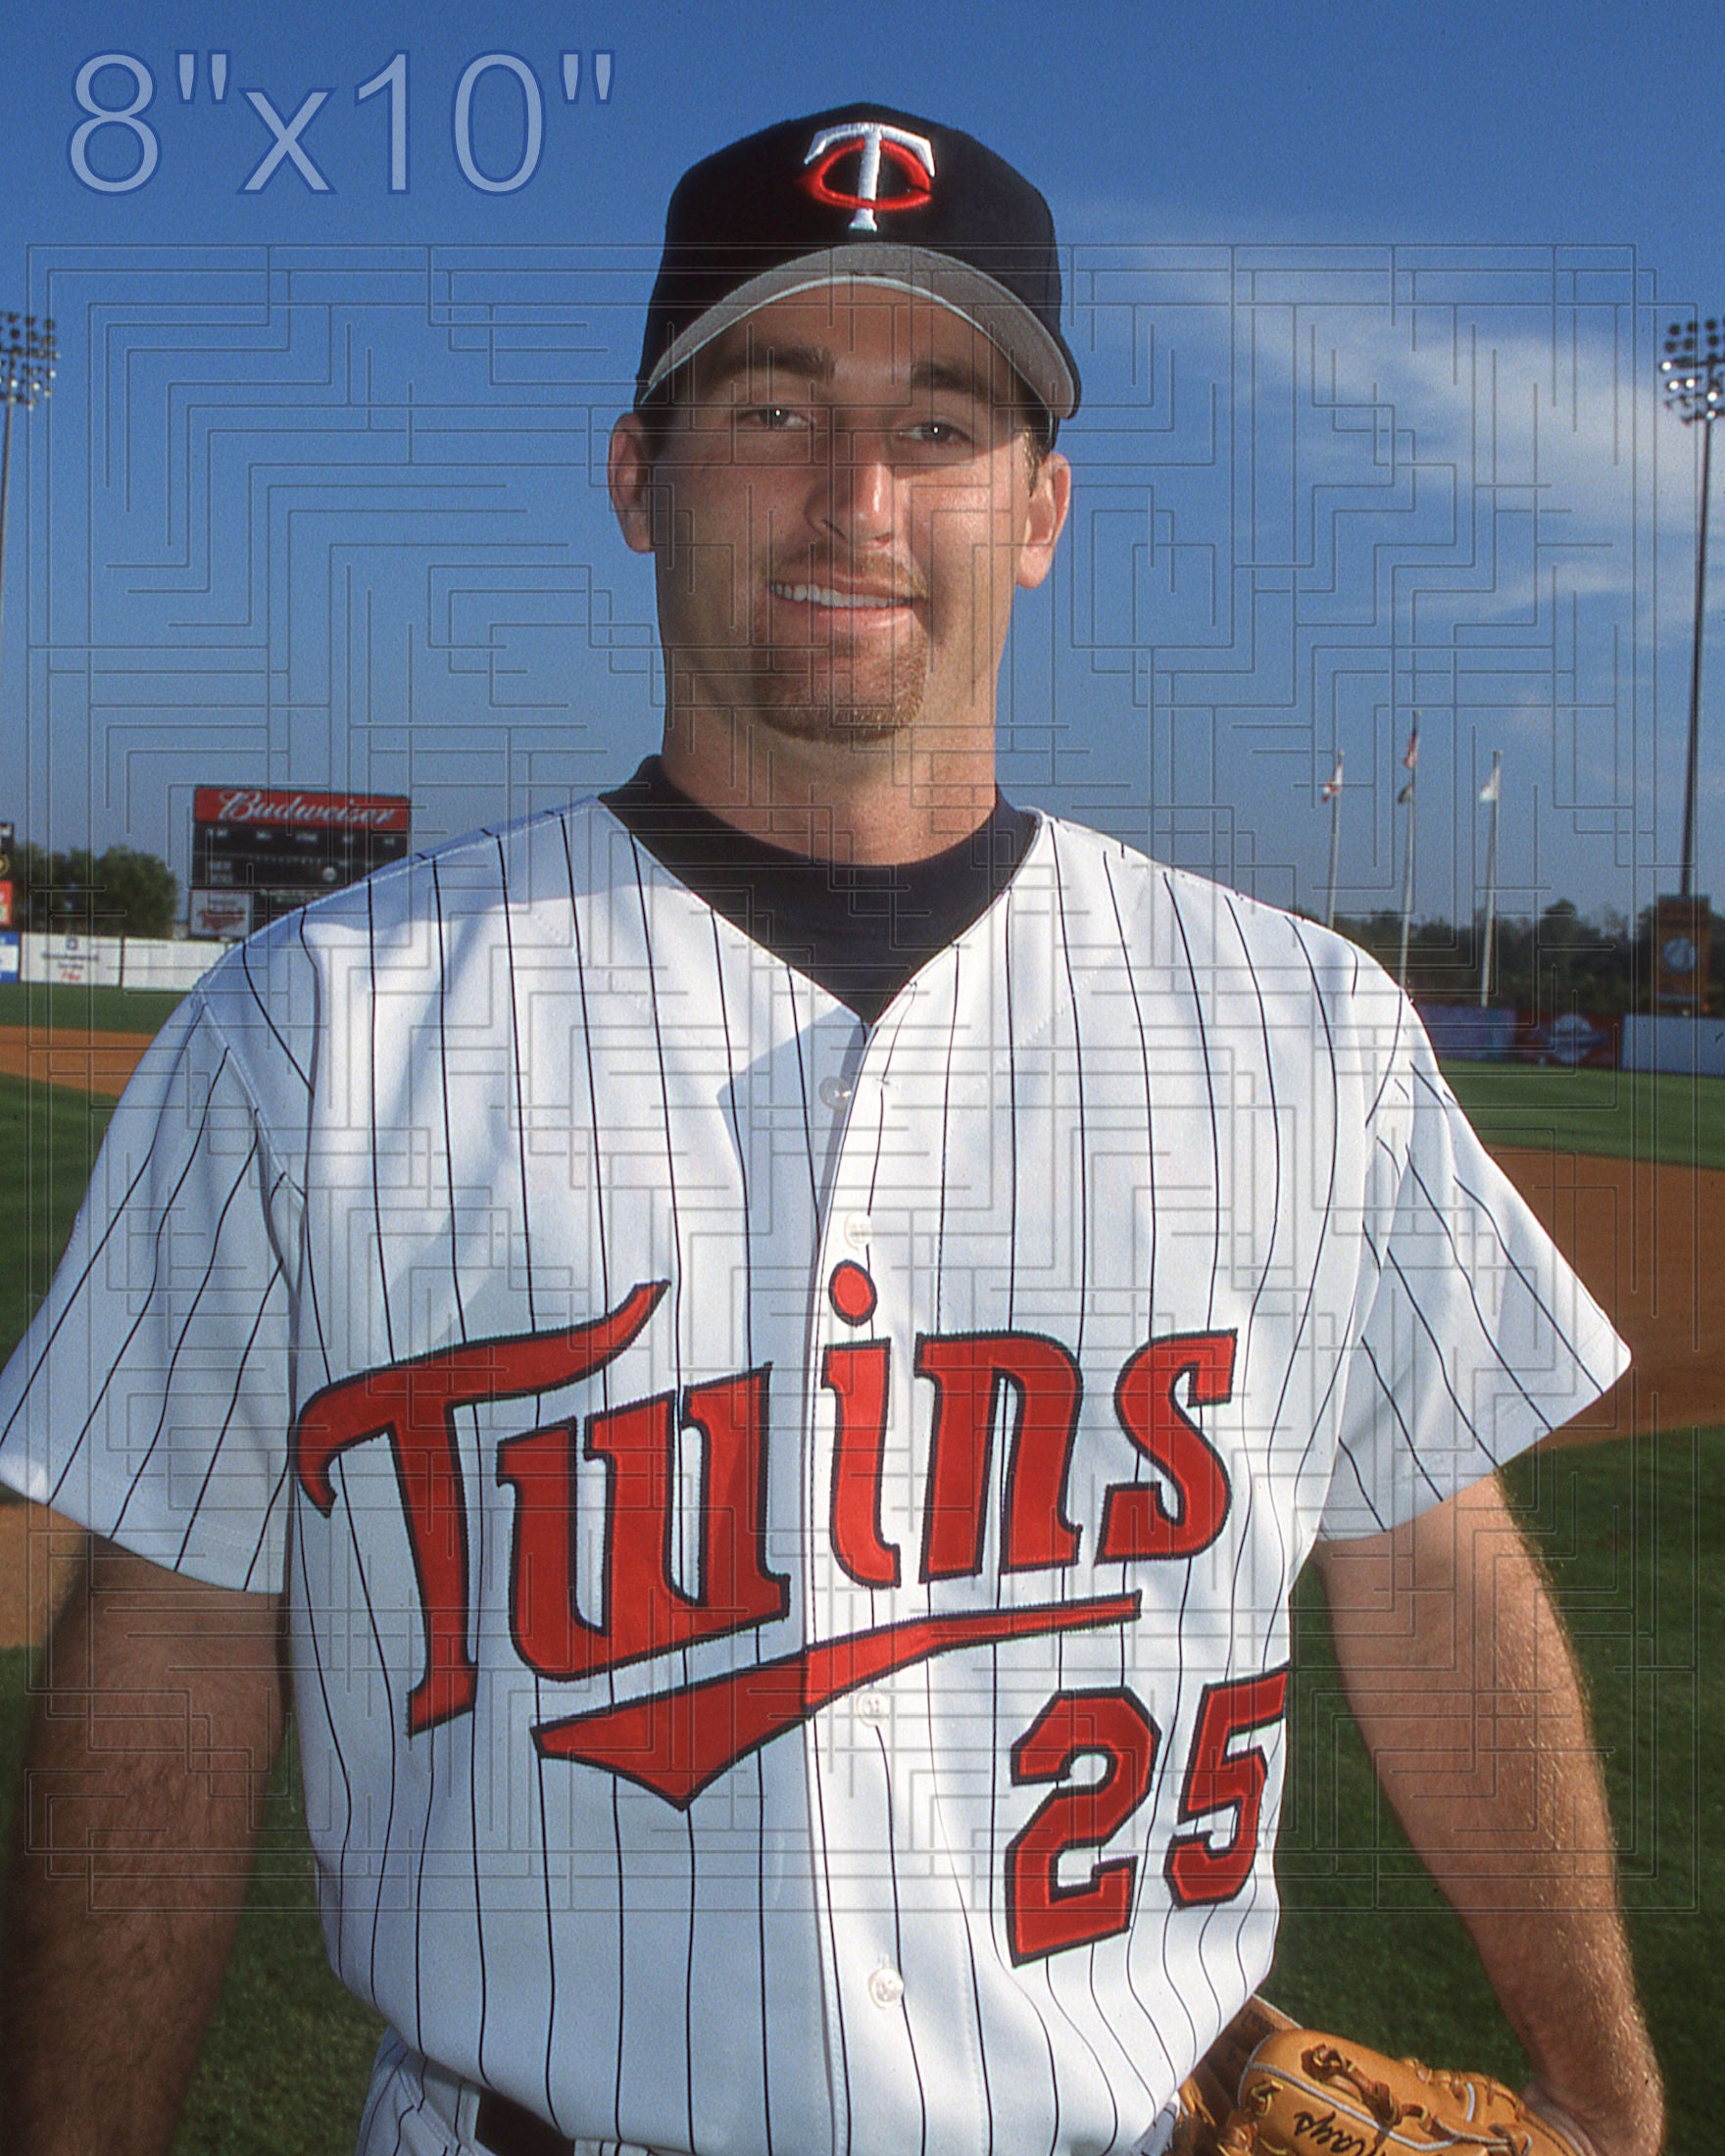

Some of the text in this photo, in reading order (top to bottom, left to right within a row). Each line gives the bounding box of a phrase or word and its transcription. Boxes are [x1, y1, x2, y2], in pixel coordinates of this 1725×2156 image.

[219, 790, 396, 825] Budweiser
[292, 1261, 1238, 1736] Twins
[1006, 1662, 1290, 1967] 25
